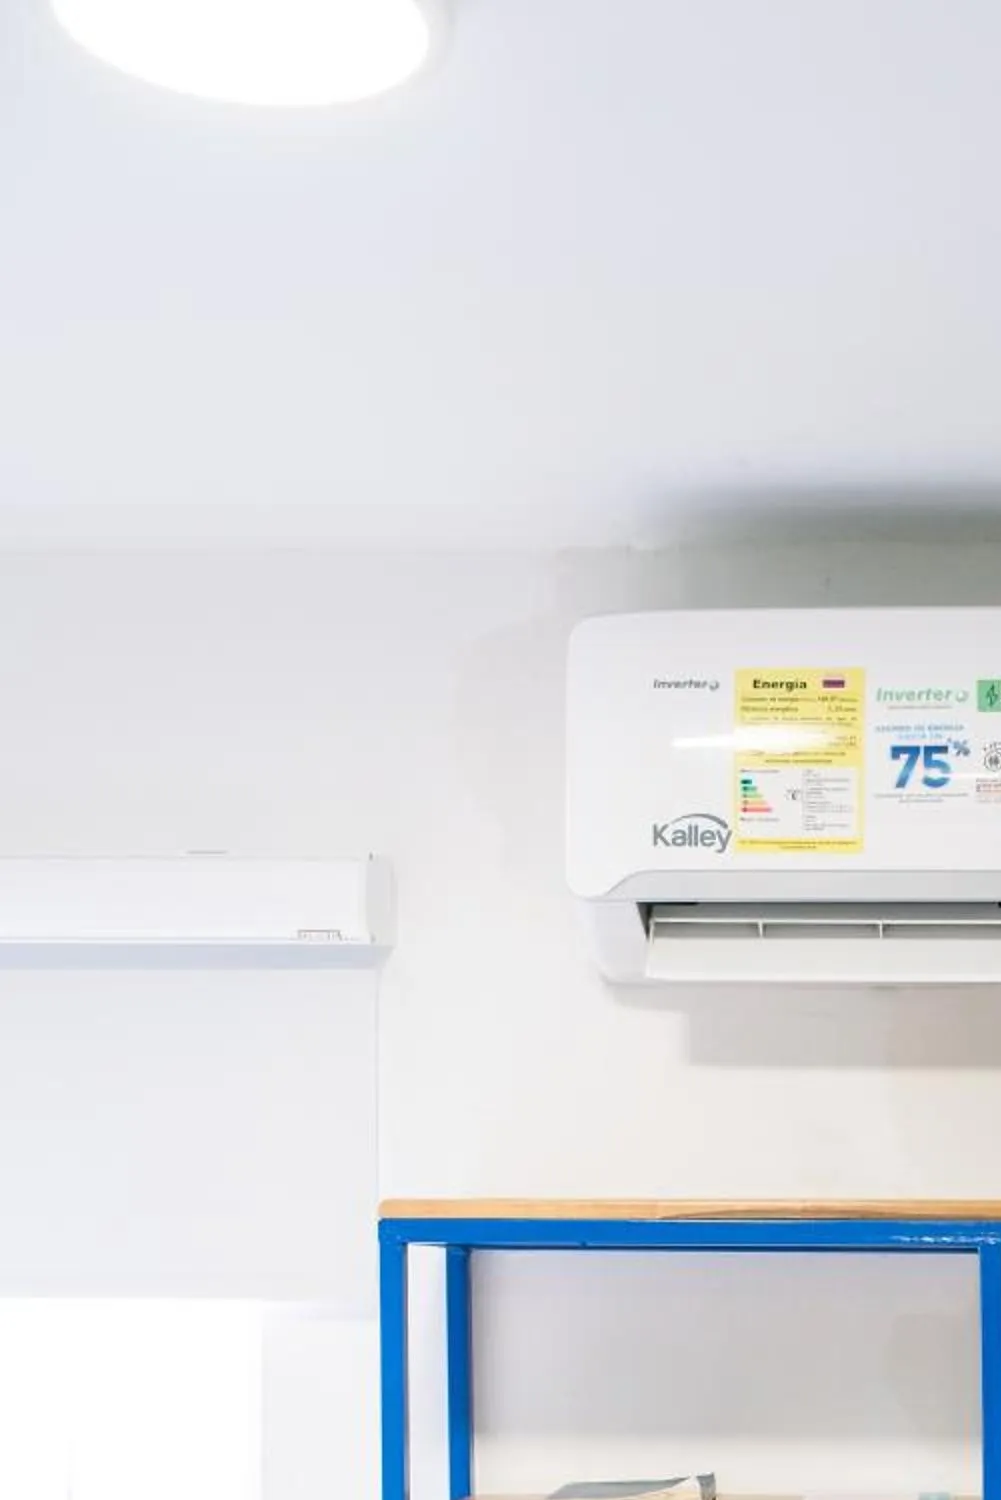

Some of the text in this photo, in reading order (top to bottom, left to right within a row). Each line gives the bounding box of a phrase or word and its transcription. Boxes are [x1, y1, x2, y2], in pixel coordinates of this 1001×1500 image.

[653, 678, 707, 689] Inverter
[876, 687, 952, 702] Inverter
[653, 820, 732, 853] Kalley
